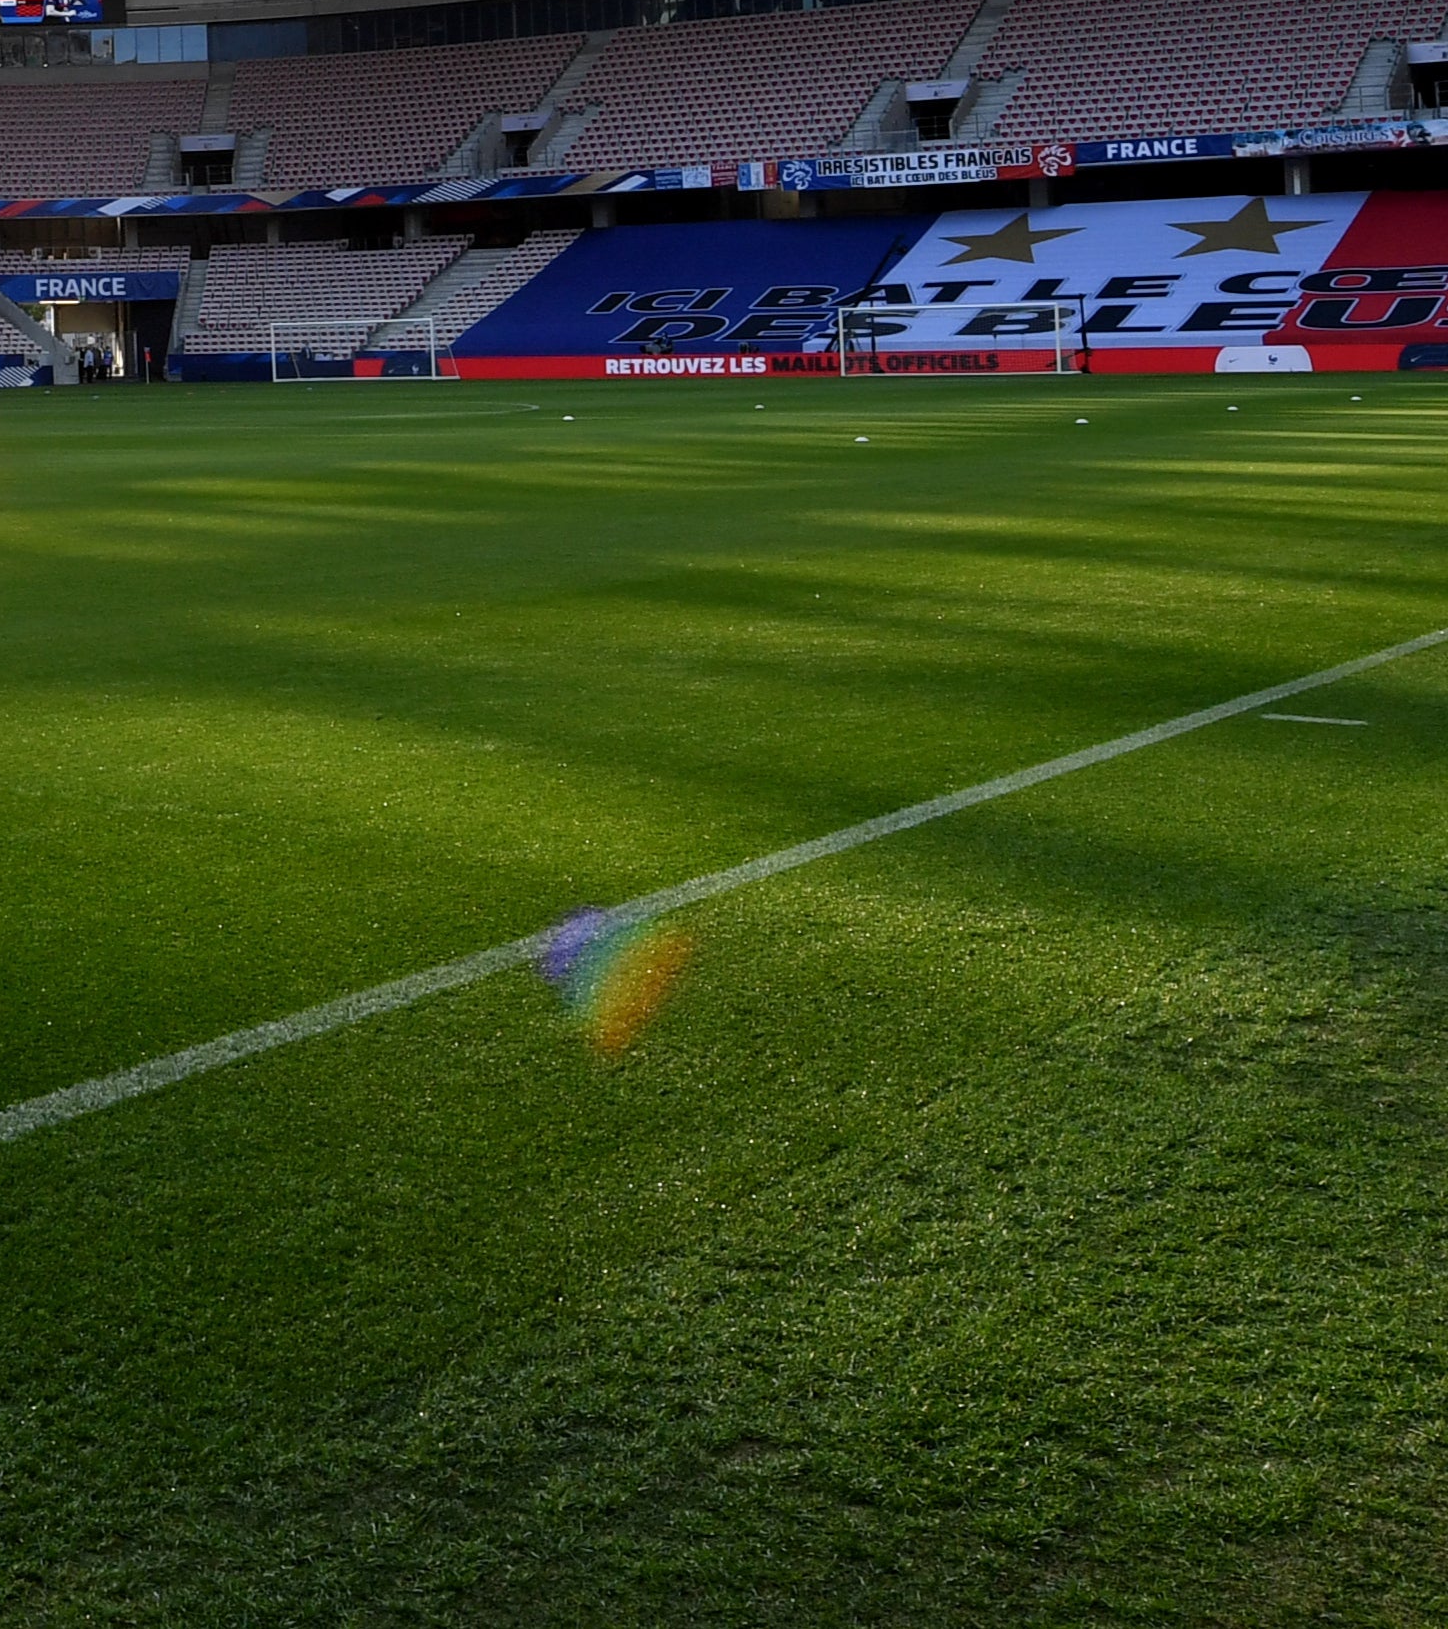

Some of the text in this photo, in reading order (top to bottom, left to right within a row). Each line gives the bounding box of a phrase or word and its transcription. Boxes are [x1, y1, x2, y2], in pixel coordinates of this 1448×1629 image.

[1106, 138, 1198, 159] FRANCE
[818, 154, 938, 175] IRRESISTIBLES
[851, 168, 996, 186] ICI BAT LE CŒUR DES BLEUS
[35, 276, 126, 297] FRANCE
[586, 286, 733, 314] ICI
[748, 279, 997, 309] BAT
[1020, 273, 1185, 301] LE
[607, 295, 1448, 344] DES BLEU
[605, 357, 725, 375] RETROUVEZ
[730, 356, 767, 373] LES
[887, 354, 1000, 371] OFFICIELS
